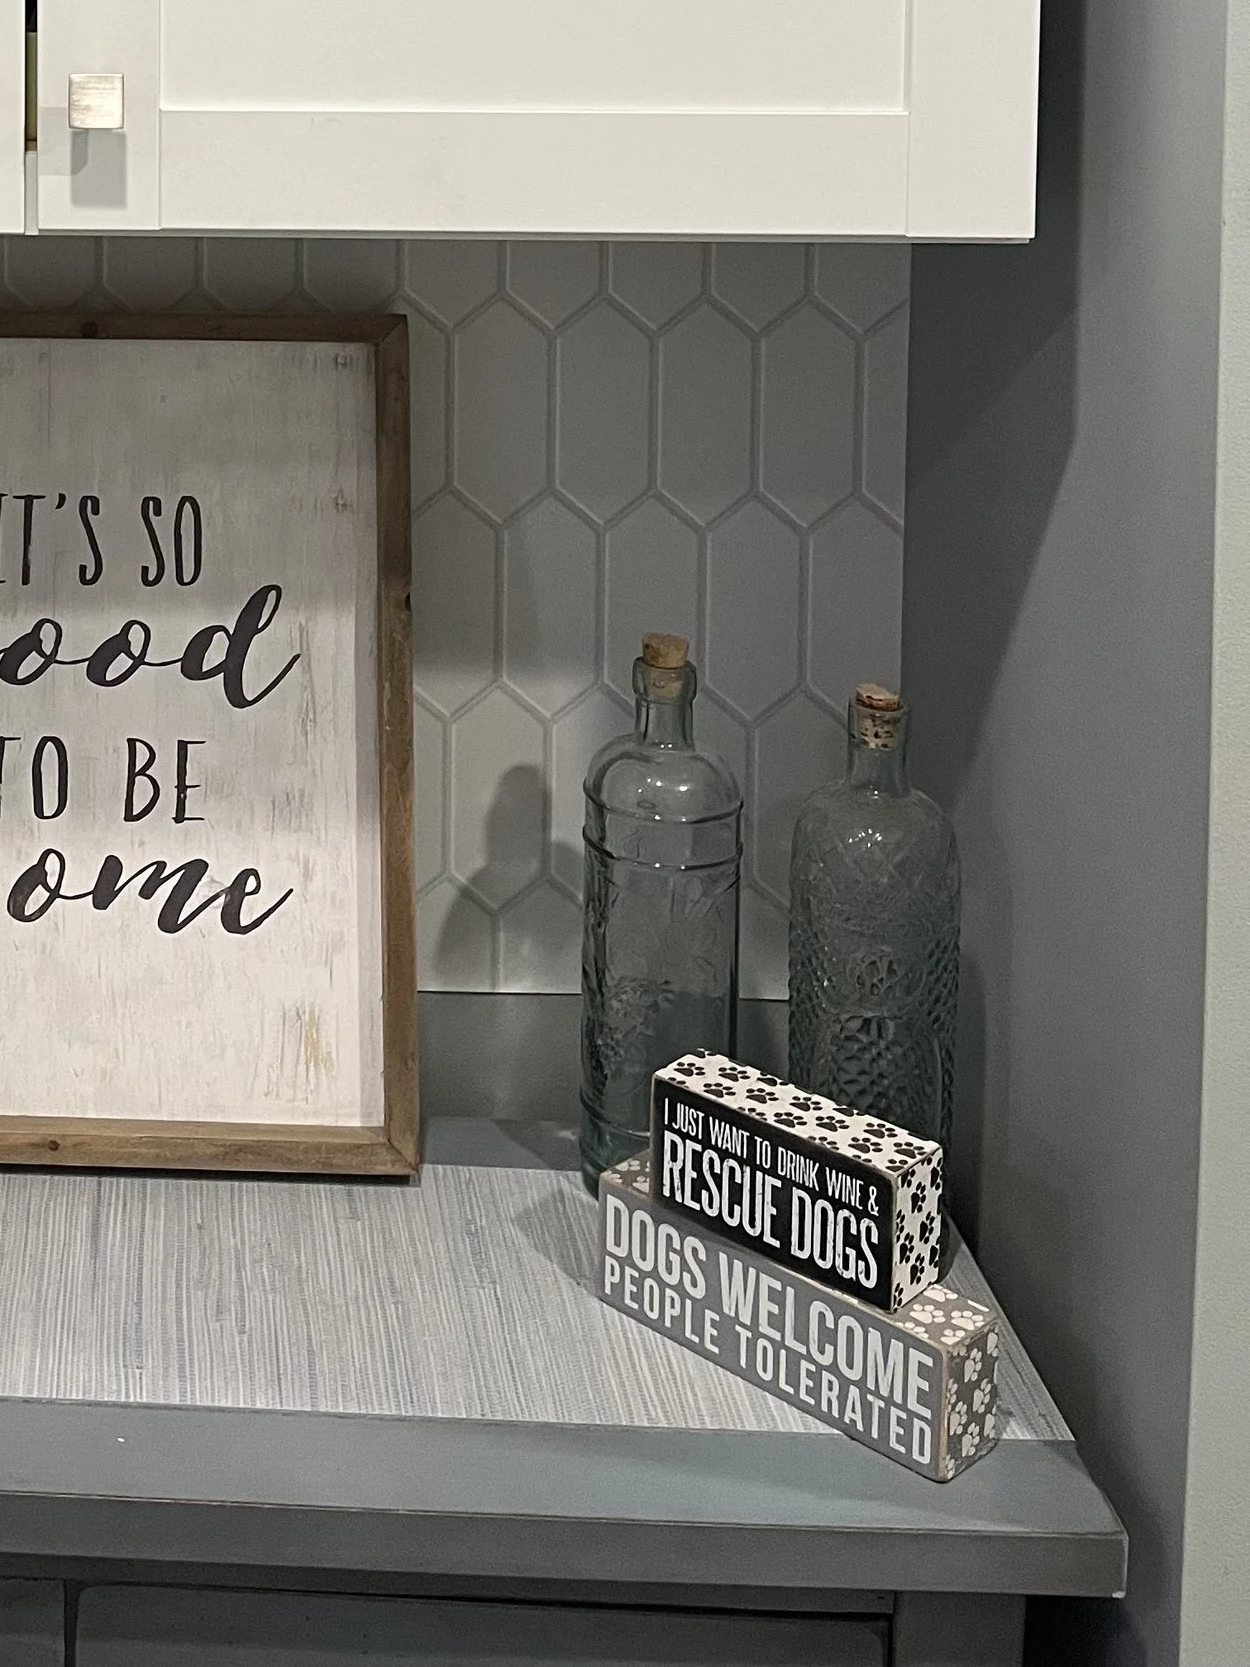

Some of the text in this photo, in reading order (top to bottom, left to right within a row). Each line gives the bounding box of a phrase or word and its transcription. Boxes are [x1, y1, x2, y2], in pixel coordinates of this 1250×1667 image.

[141, 495, 202, 587] SO
[123, 737, 207, 824] BE
[662, 1130, 879, 1289] RESCUE DOGS
[664, 1097, 879, 1216] I JUST WANT TO DRINK WINE &
[604, 1255, 933, 1465] PEOPLE TOLERATED
[605, 1194, 934, 1421] DOGS WELCOME
